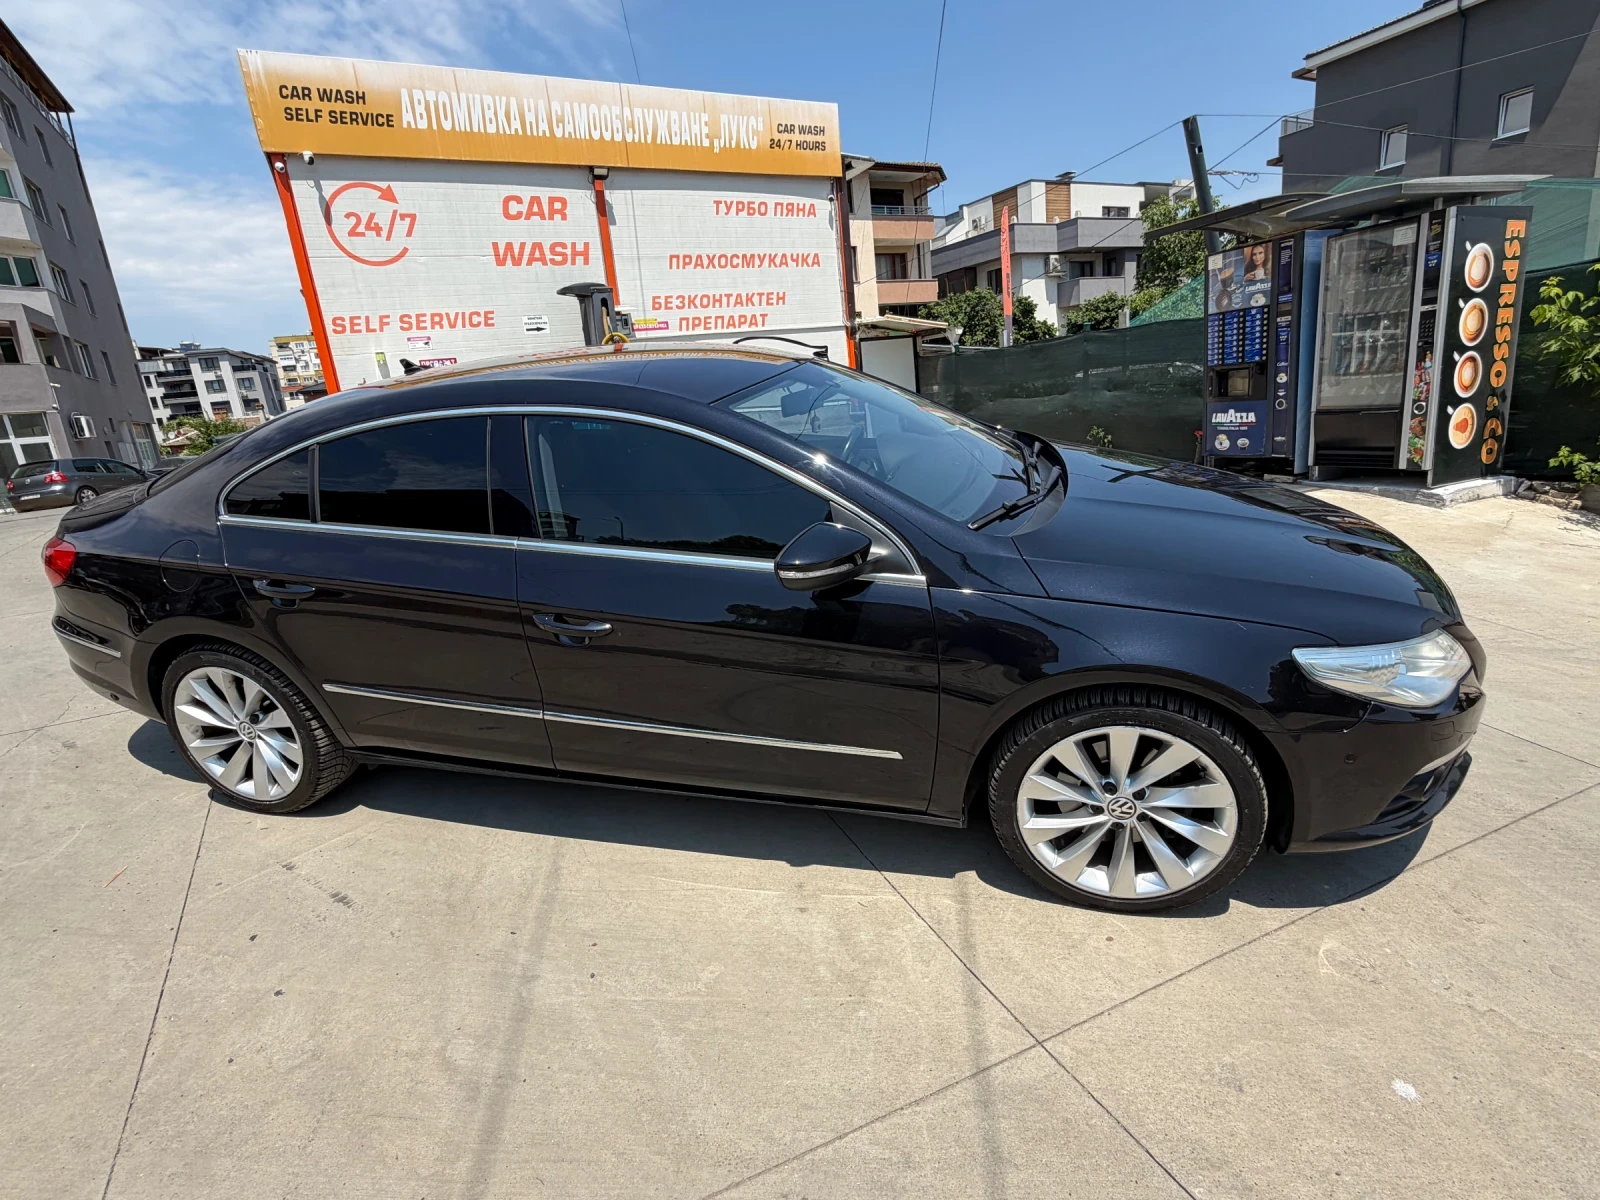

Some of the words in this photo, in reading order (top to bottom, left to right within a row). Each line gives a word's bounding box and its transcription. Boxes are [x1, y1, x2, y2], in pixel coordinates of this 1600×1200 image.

[278, 84, 313, 102] CAR
[316, 87, 366, 105] WASH
[284, 106, 323, 124] SELF
[328, 109, 395, 128] SERVICE
[400, 87, 523, 136] АВТОМИВКА
[523, 97, 550, 138] НА
[551, 100, 710, 147] САМООБСЛУЖВАНЕ
[776, 122, 796, 135] CAR
[798, 124, 825, 137] WASH
[768, 138, 793, 151] 24/7
[795, 139, 827, 152] HOURS
[502, 194, 568, 221] CAR
[712, 199, 769, 217] ТУРБО
[773, 201, 817, 218] ПЯНА
[343, 208, 418, 242] 24/7
[491, 241, 590, 267] WASH
[668, 252, 821, 270] ПРАХОСМУКАЧКА
[651, 291, 787, 311] БЕЗКОНТАКТЕН
[1489, 219, 1526, 388] ESPRESSO
[331, 313, 391, 335] SELF
[398, 309, 496, 332] SERVICE
[678, 313, 769, 332] ПРЕПАРАТ
[1486, 395, 1499, 411] &
[1211, 408, 1256, 423] LAVAZZA
[1480, 417, 1503, 465] CO
